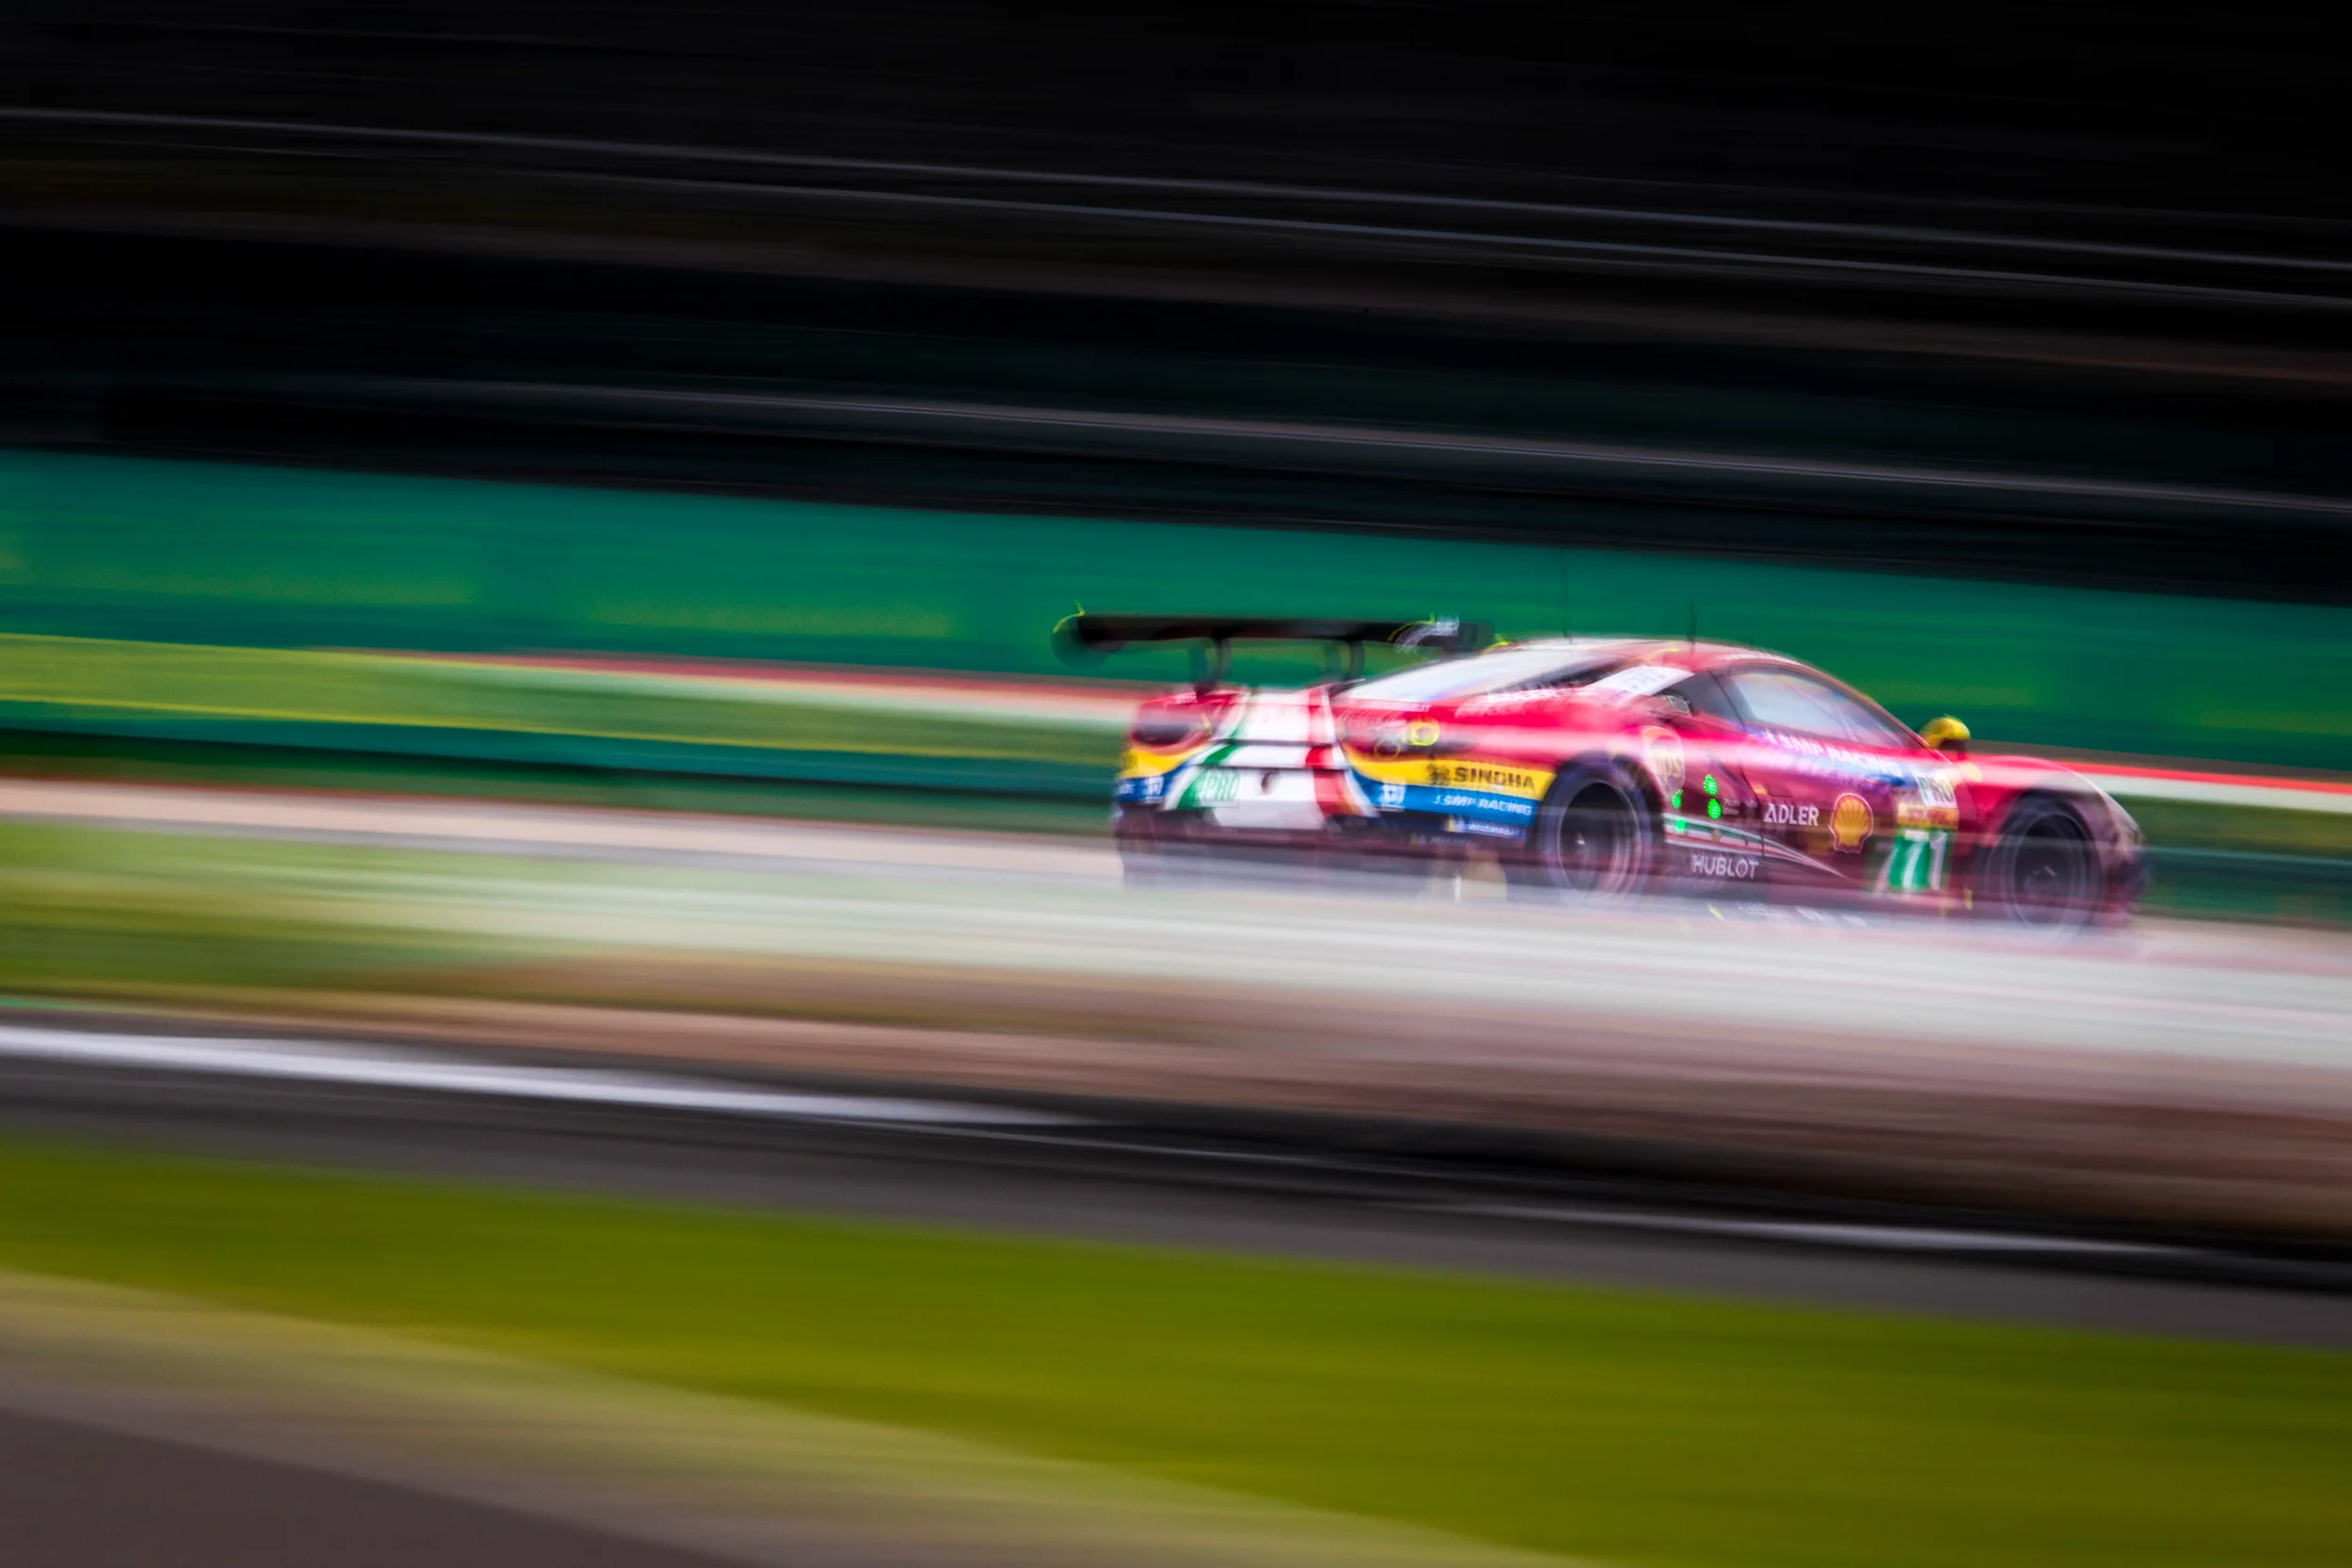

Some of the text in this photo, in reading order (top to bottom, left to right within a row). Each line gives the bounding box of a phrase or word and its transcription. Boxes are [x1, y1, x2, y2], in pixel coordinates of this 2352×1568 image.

[1454, 767, 1535, 792] SINGHA
[1763, 803, 1820, 826] ADLER
[1691, 855, 1759, 879] HUBLOT
